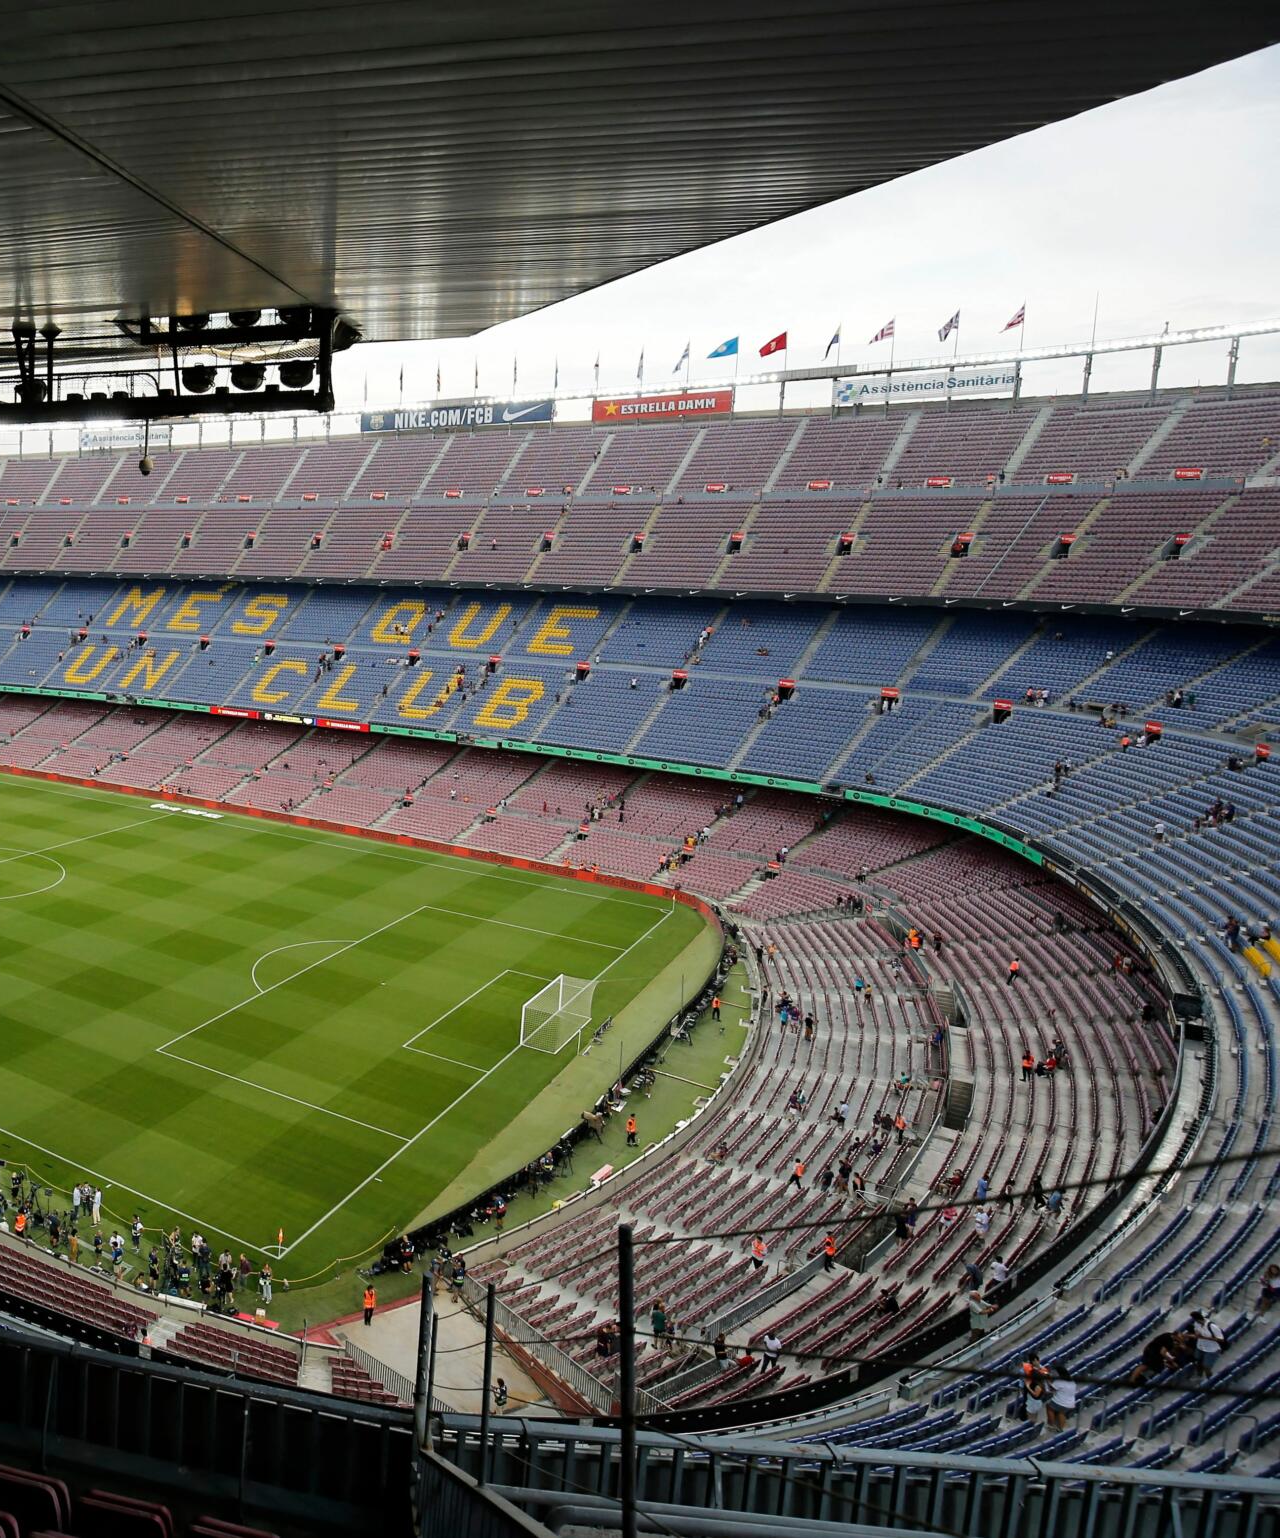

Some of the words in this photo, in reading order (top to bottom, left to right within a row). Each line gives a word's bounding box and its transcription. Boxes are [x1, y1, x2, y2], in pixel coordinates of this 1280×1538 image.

[859, 379, 945, 396] Assistència
[946, 374, 1016, 389] Sanitària
[621, 400, 676, 414] ESTRELLA
[678, 398, 716, 410] DAMM
[394, 407, 493, 429] NIKE.COM/FCB
[107, 583, 288, 634] MÉS
[372, 600, 599, 655] QUE
[64, 645, 180, 690] UN
[252, 660, 545, 730] CLUB
